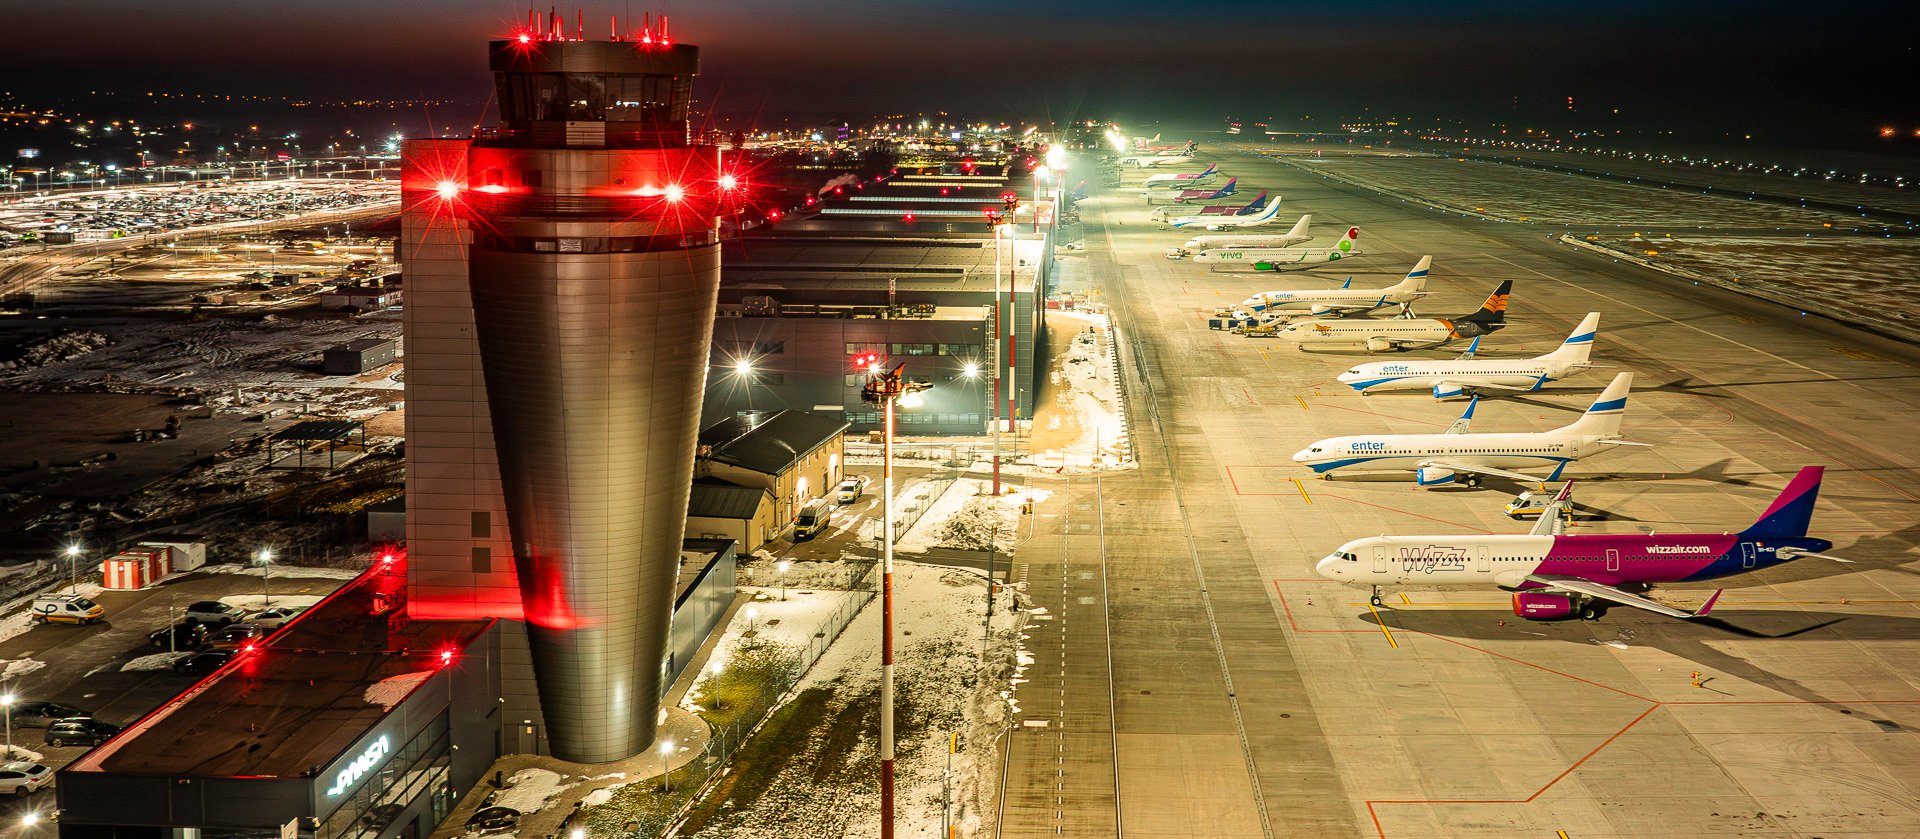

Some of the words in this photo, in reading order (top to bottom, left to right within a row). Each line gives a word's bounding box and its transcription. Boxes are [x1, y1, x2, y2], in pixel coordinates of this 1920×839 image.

[1351, 441, 1385, 450] enter
[1645, 544, 1711, 554] wizzair.com
[327, 735, 389, 796] PANSA
